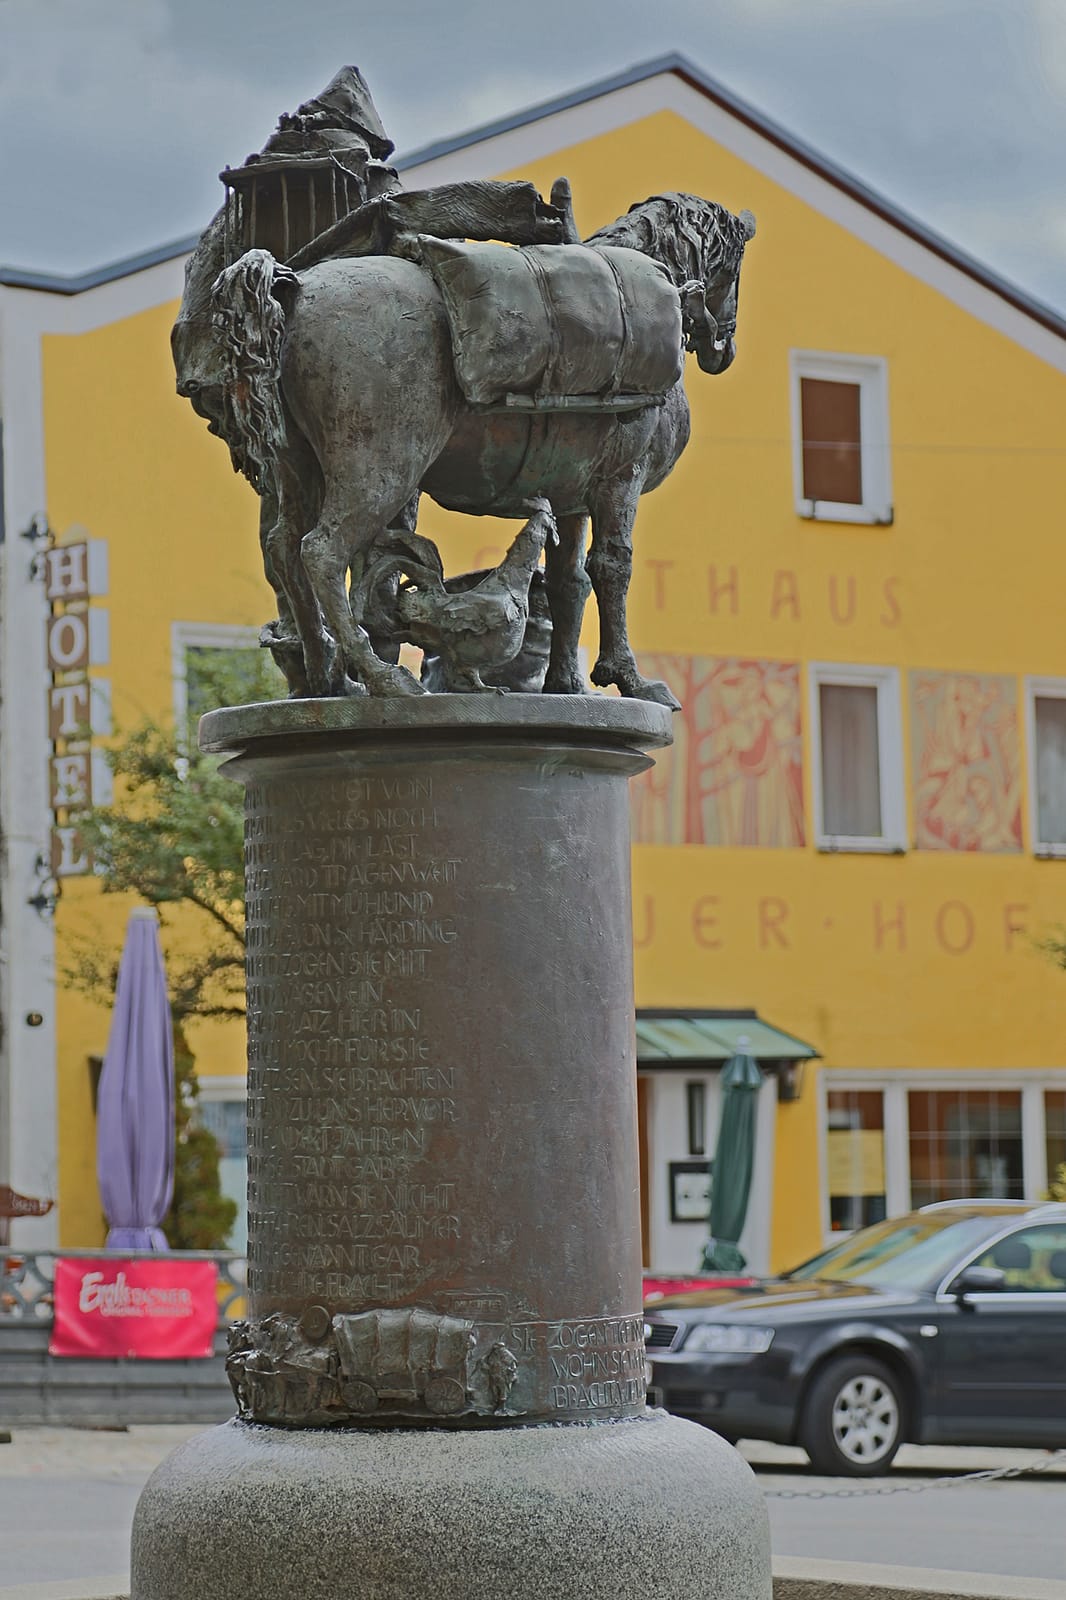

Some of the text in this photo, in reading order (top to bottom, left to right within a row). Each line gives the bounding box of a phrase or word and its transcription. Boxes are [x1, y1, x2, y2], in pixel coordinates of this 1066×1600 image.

[48, 544, 90, 874] HOTEL
[375, 807, 440, 830] NOCH
[321, 861, 407, 887] TRAGEN
[408, 858, 464, 884] WEIT
[872, 898, 1031, 956] HOF
[384, 948, 433, 976] MIT
[338, 1007, 388, 1033] HIER
[392, 1007, 421, 1031] IN
[392, 1036, 431, 1062] SIE
[351, 1066, 456, 1092] BRACHTEN
[366, 1096, 462, 1123] HERVOR
[333, 1126, 426, 1152] JAHREN
[384, 1182, 456, 1210] NICHT
[372, 1243, 421, 1269] GAR
[548, 1322, 608, 1349] ZOGEN
